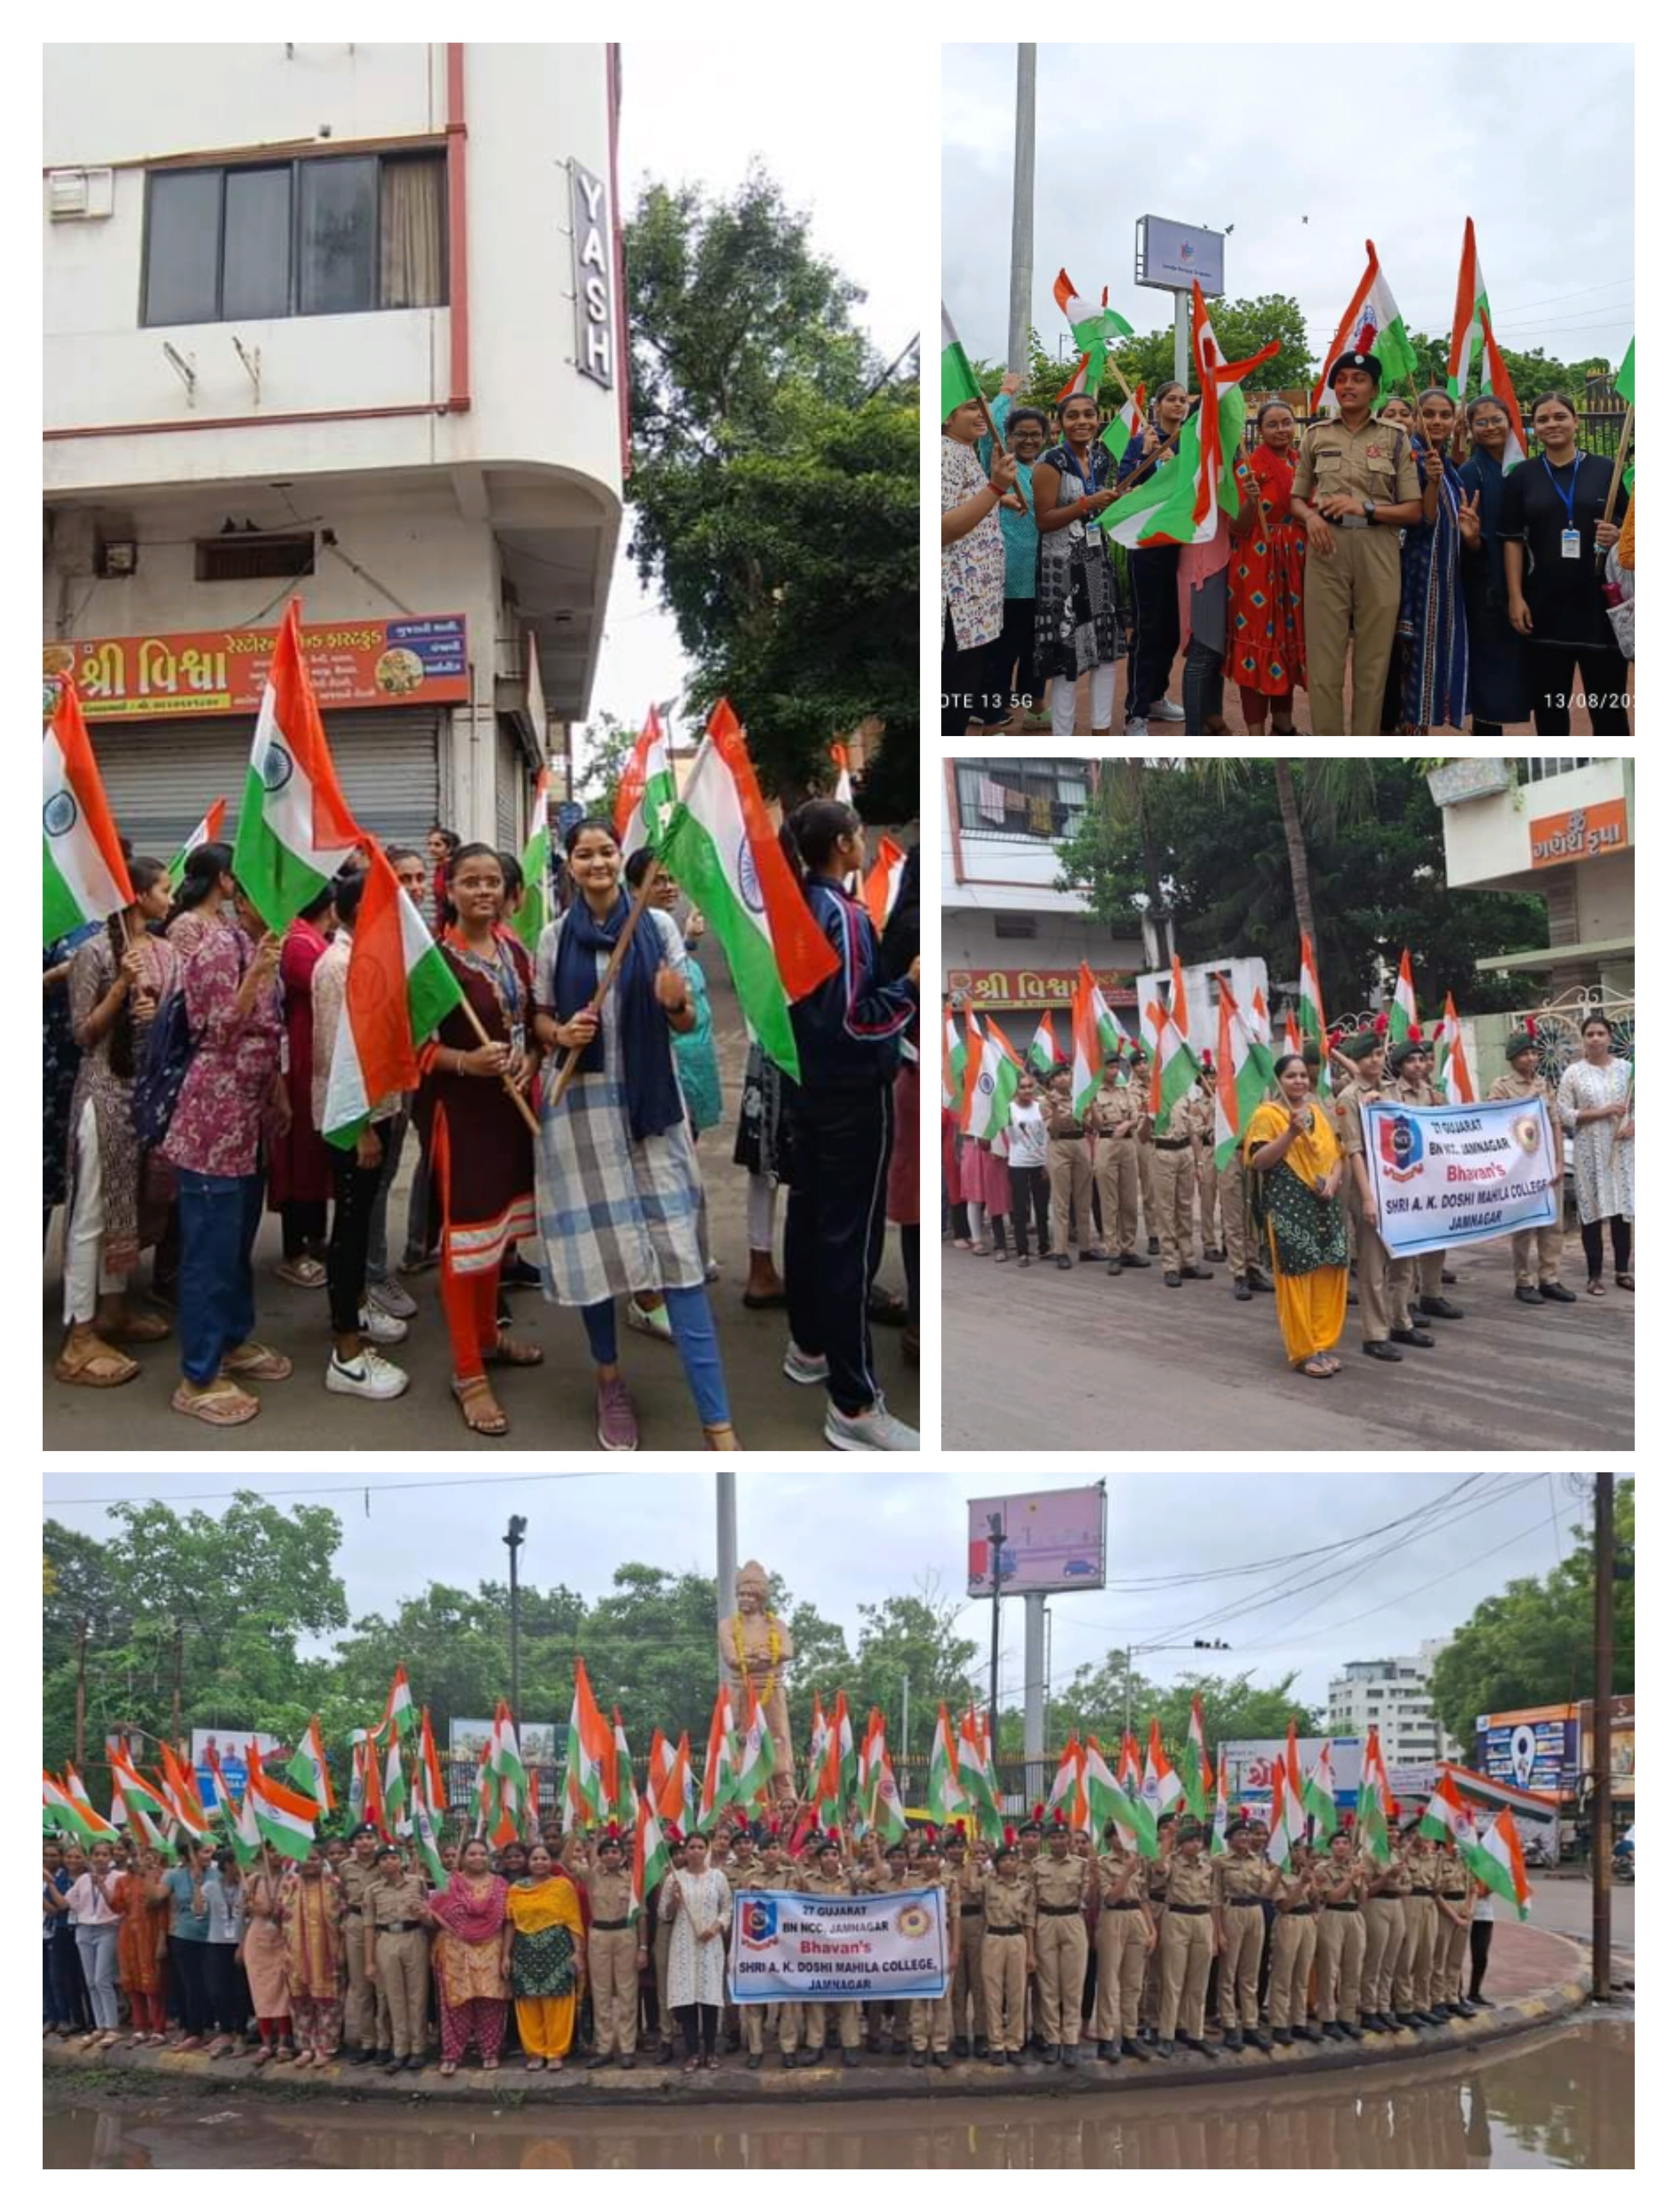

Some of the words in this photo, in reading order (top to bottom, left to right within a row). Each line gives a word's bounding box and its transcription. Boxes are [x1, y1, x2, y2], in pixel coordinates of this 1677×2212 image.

[579, 173, 609, 376] YASH
[79, 642, 125, 696] શ્રી
[138, 639, 227, 694] વિશ્વા
[975, 973, 1009, 999] શ્રી
[1462, 1137, 1511, 1155] JAMNAGAR
[1446, 1162, 1506, 1182] Bhavan's
[1385, 1198, 1409, 1215] SHRI
[1411, 1198, 1423, 1211] A.
[1426, 1196, 1438, 1210] K.
[1441, 1192, 1475, 1210] DOSHI
[1477, 1188, 1510, 1205] MAHILA
[1449, 1210, 1503, 1231] JAMNAGAR
[803, 1905, 815, 1916] 27
[817, 1906, 868, 1917] GUJARAT
[783, 1923, 798, 1933] BN
[829, 1921, 889, 1933] JAMNAGAR
[799, 1940, 871, 1954] Bhavan's
[739, 1962, 766, 1974] SHRI
[768, 1963, 779, 1973] A.
[783, 1963, 795, 1973] K.
[797, 1961, 833, 1973] DOSHI
[836, 1961, 879, 1973] MAHILA
[882, 1958, 938, 1973] COLLEGE,
[808, 1979, 871, 1991] JAMNAGAR
